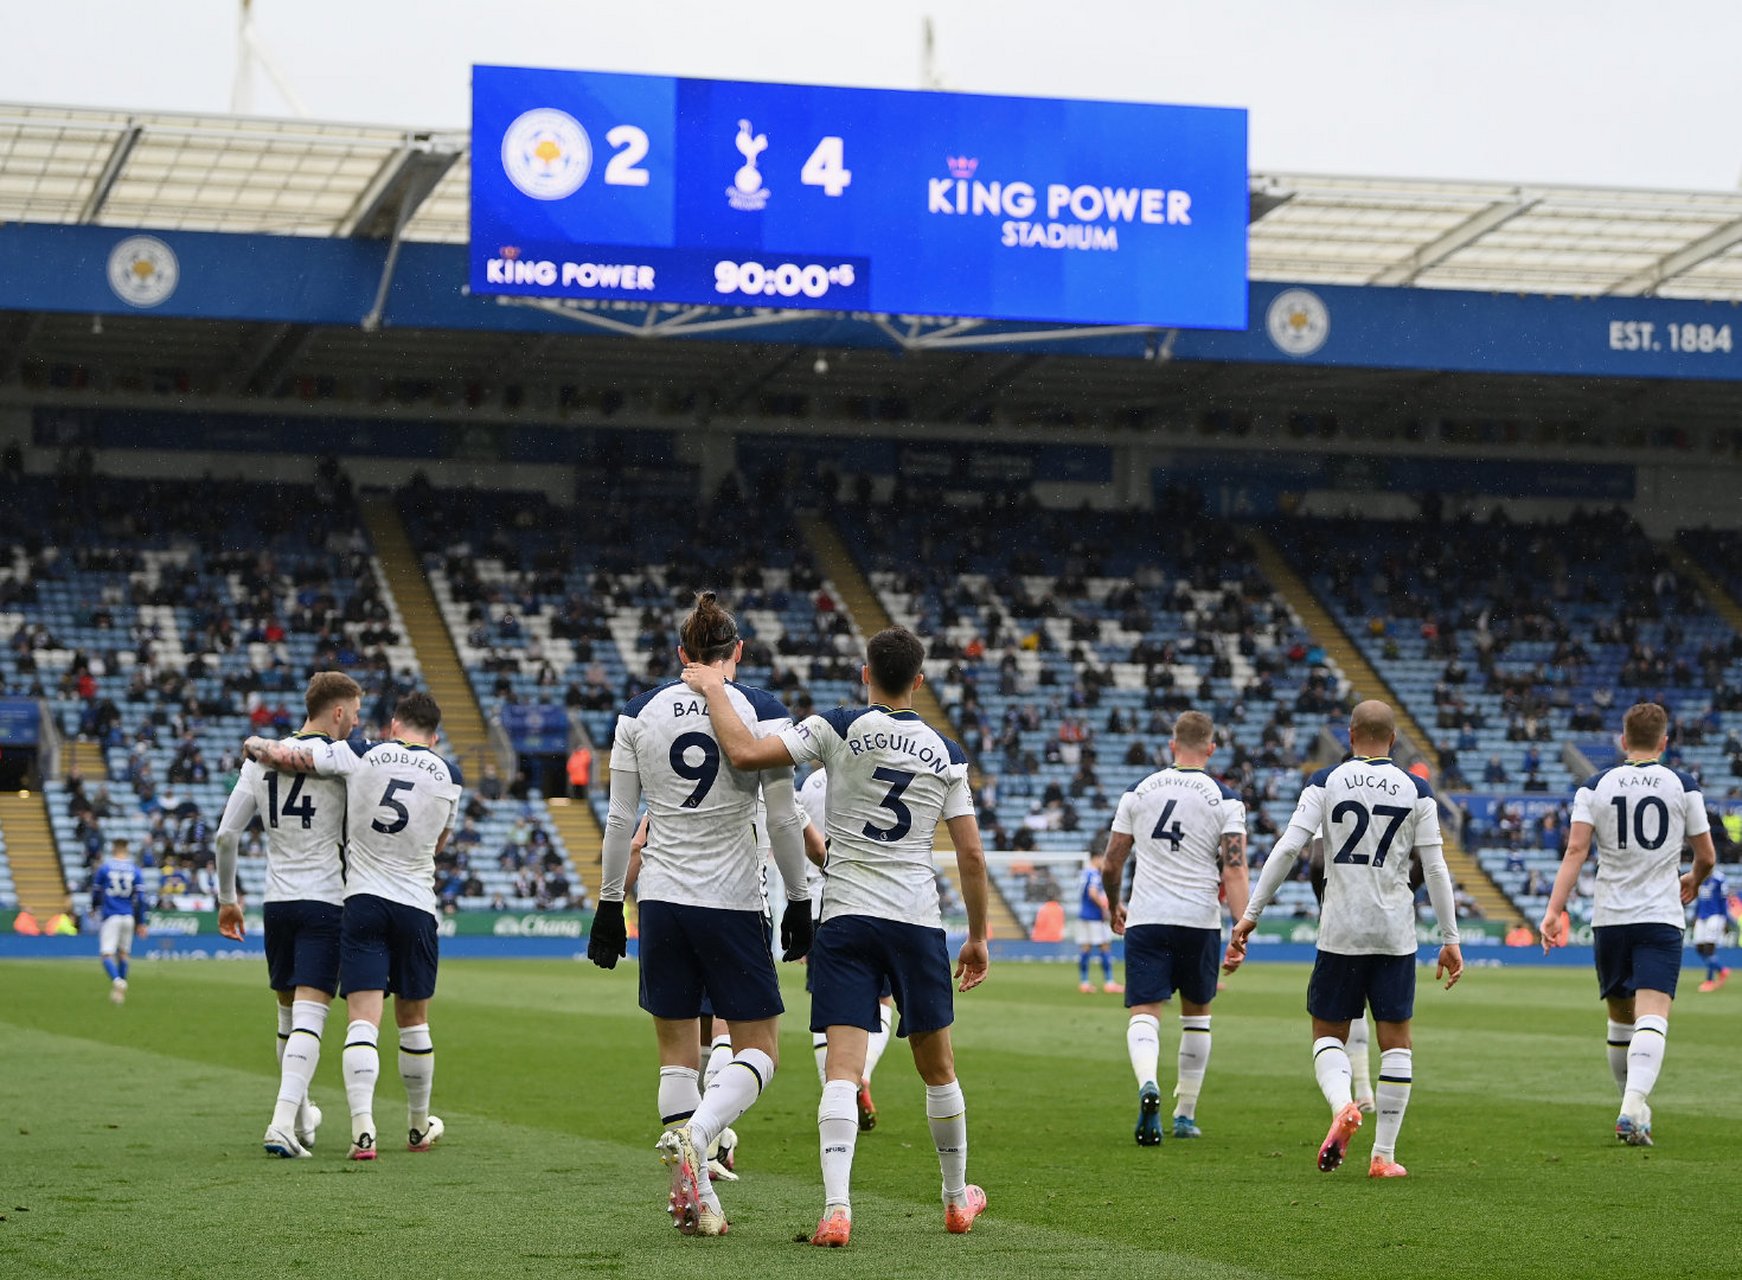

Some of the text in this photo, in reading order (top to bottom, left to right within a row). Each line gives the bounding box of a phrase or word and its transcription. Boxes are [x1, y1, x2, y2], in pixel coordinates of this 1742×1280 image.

[604, 125, 649, 187] 2
[801, 136, 851, 197] 4
[928, 177, 1192, 226] KING POWER
[1001, 220, 1119, 251] STADIUM
[487, 258, 655, 291] KING POWER
[1609, 320, 1732, 353] EST. 1884
[673, 700, 710, 717] BAL
[368, 752, 446, 782] HØJBJERG
[669, 731, 720, 808] 9
[848, 733, 948, 775] REGUILÓN
[262, 770, 317, 830] 14
[370, 778, 416, 835] 5
[861, 766, 917, 842] 3
[1344, 774, 1400, 796] LUCAS
[1619, 776, 1662, 789] KANE
[1151, 799, 1185, 852] 4
[1331, 800, 1413, 868] 27
[1611, 796, 1669, 851] 10
[520, 914, 582, 938] Chang
